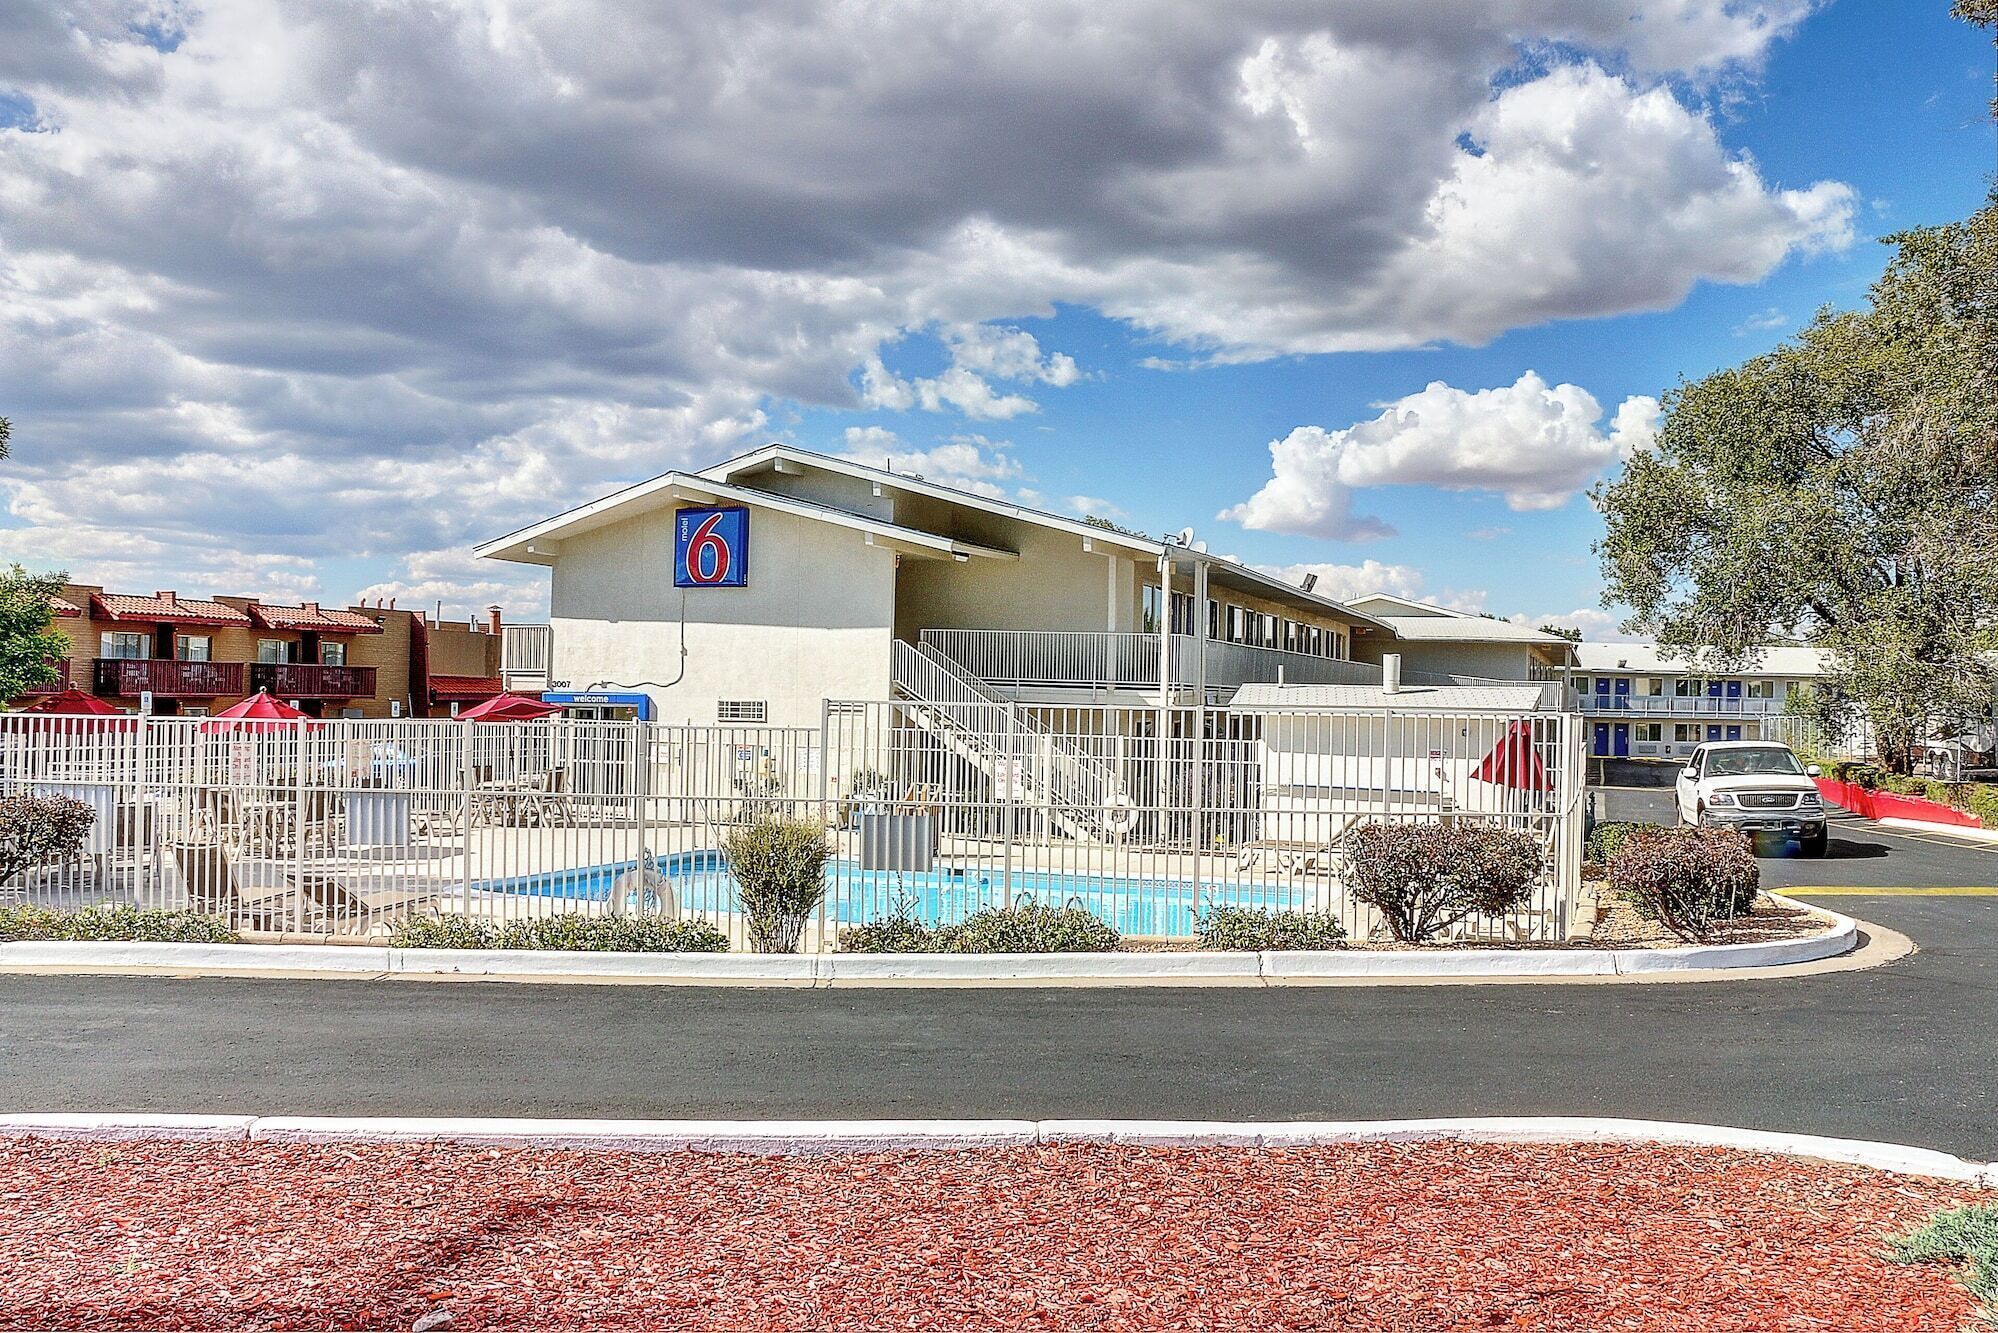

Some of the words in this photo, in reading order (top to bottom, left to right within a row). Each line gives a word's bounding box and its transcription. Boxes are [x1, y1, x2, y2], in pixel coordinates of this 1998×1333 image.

[681, 518, 689, 541] motel
[686, 512, 731, 583] 6
[552, 680, 571, 689] 3007
[573, 694, 609, 703] welcome
